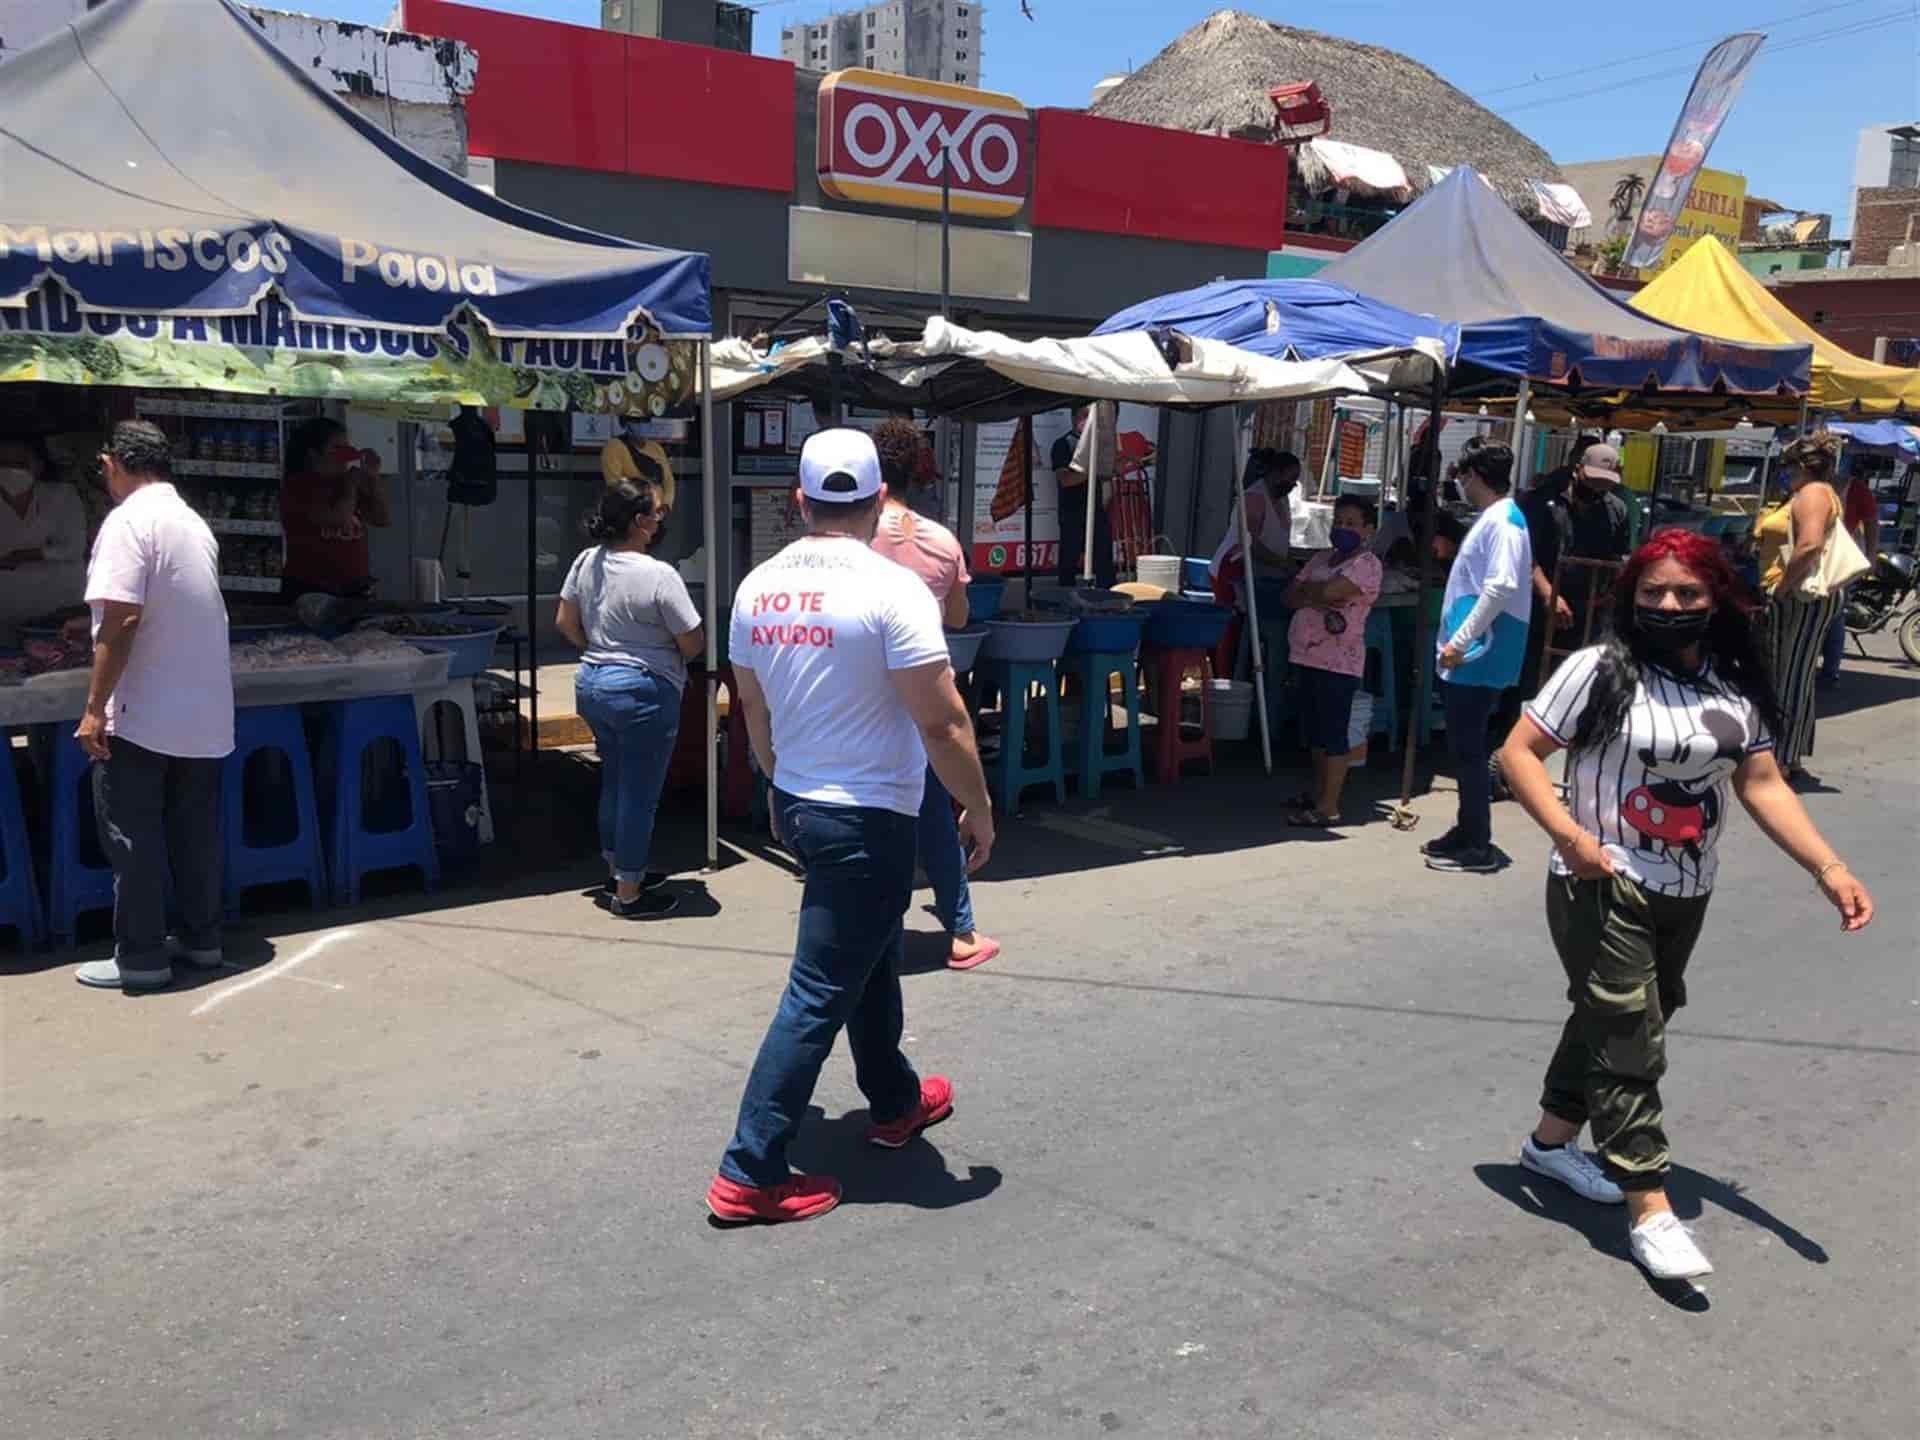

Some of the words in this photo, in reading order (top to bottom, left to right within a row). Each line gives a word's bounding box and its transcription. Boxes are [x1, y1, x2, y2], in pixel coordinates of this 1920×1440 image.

[844, 102, 1018, 185] OXXO
[0, 224, 291, 274] Mariscos
[341, 239, 497, 296] Paola
[752, 591, 791, 617] ¡YO
[798, 591, 824, 612] TE
[751, 622, 835, 649] AYUDO!
